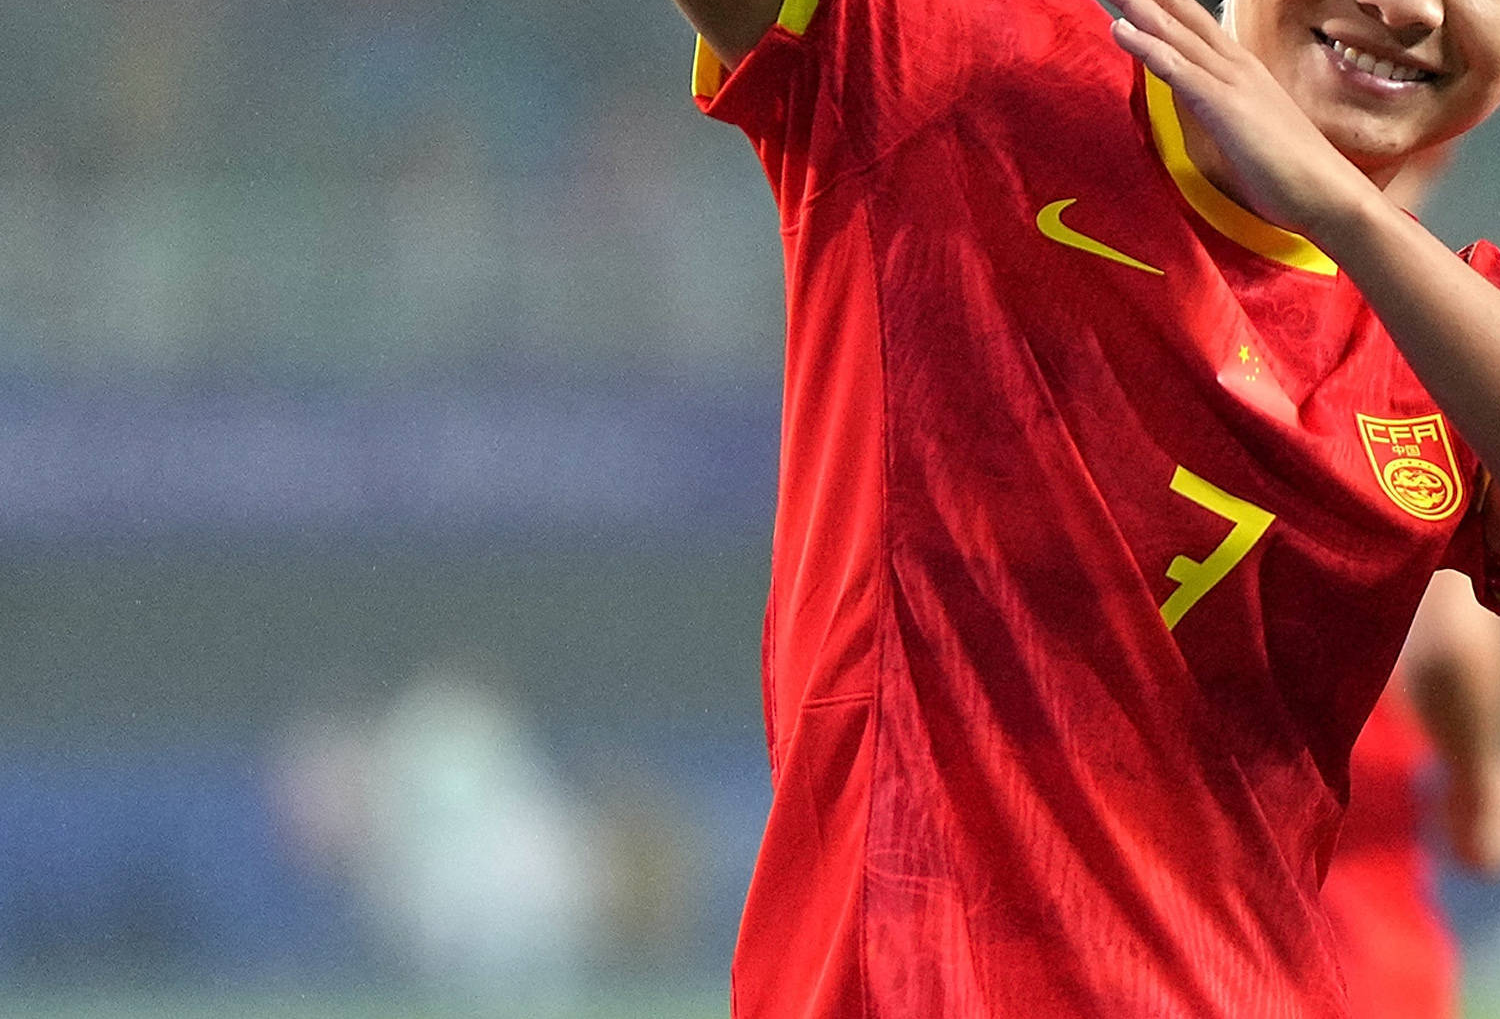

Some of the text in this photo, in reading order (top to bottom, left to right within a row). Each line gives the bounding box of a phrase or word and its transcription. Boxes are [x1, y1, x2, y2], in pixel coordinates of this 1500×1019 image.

[1365, 423, 1439, 445] CFA
[1391, 444, 1421, 457] 中国
[1158, 464, 1277, 631] 7
